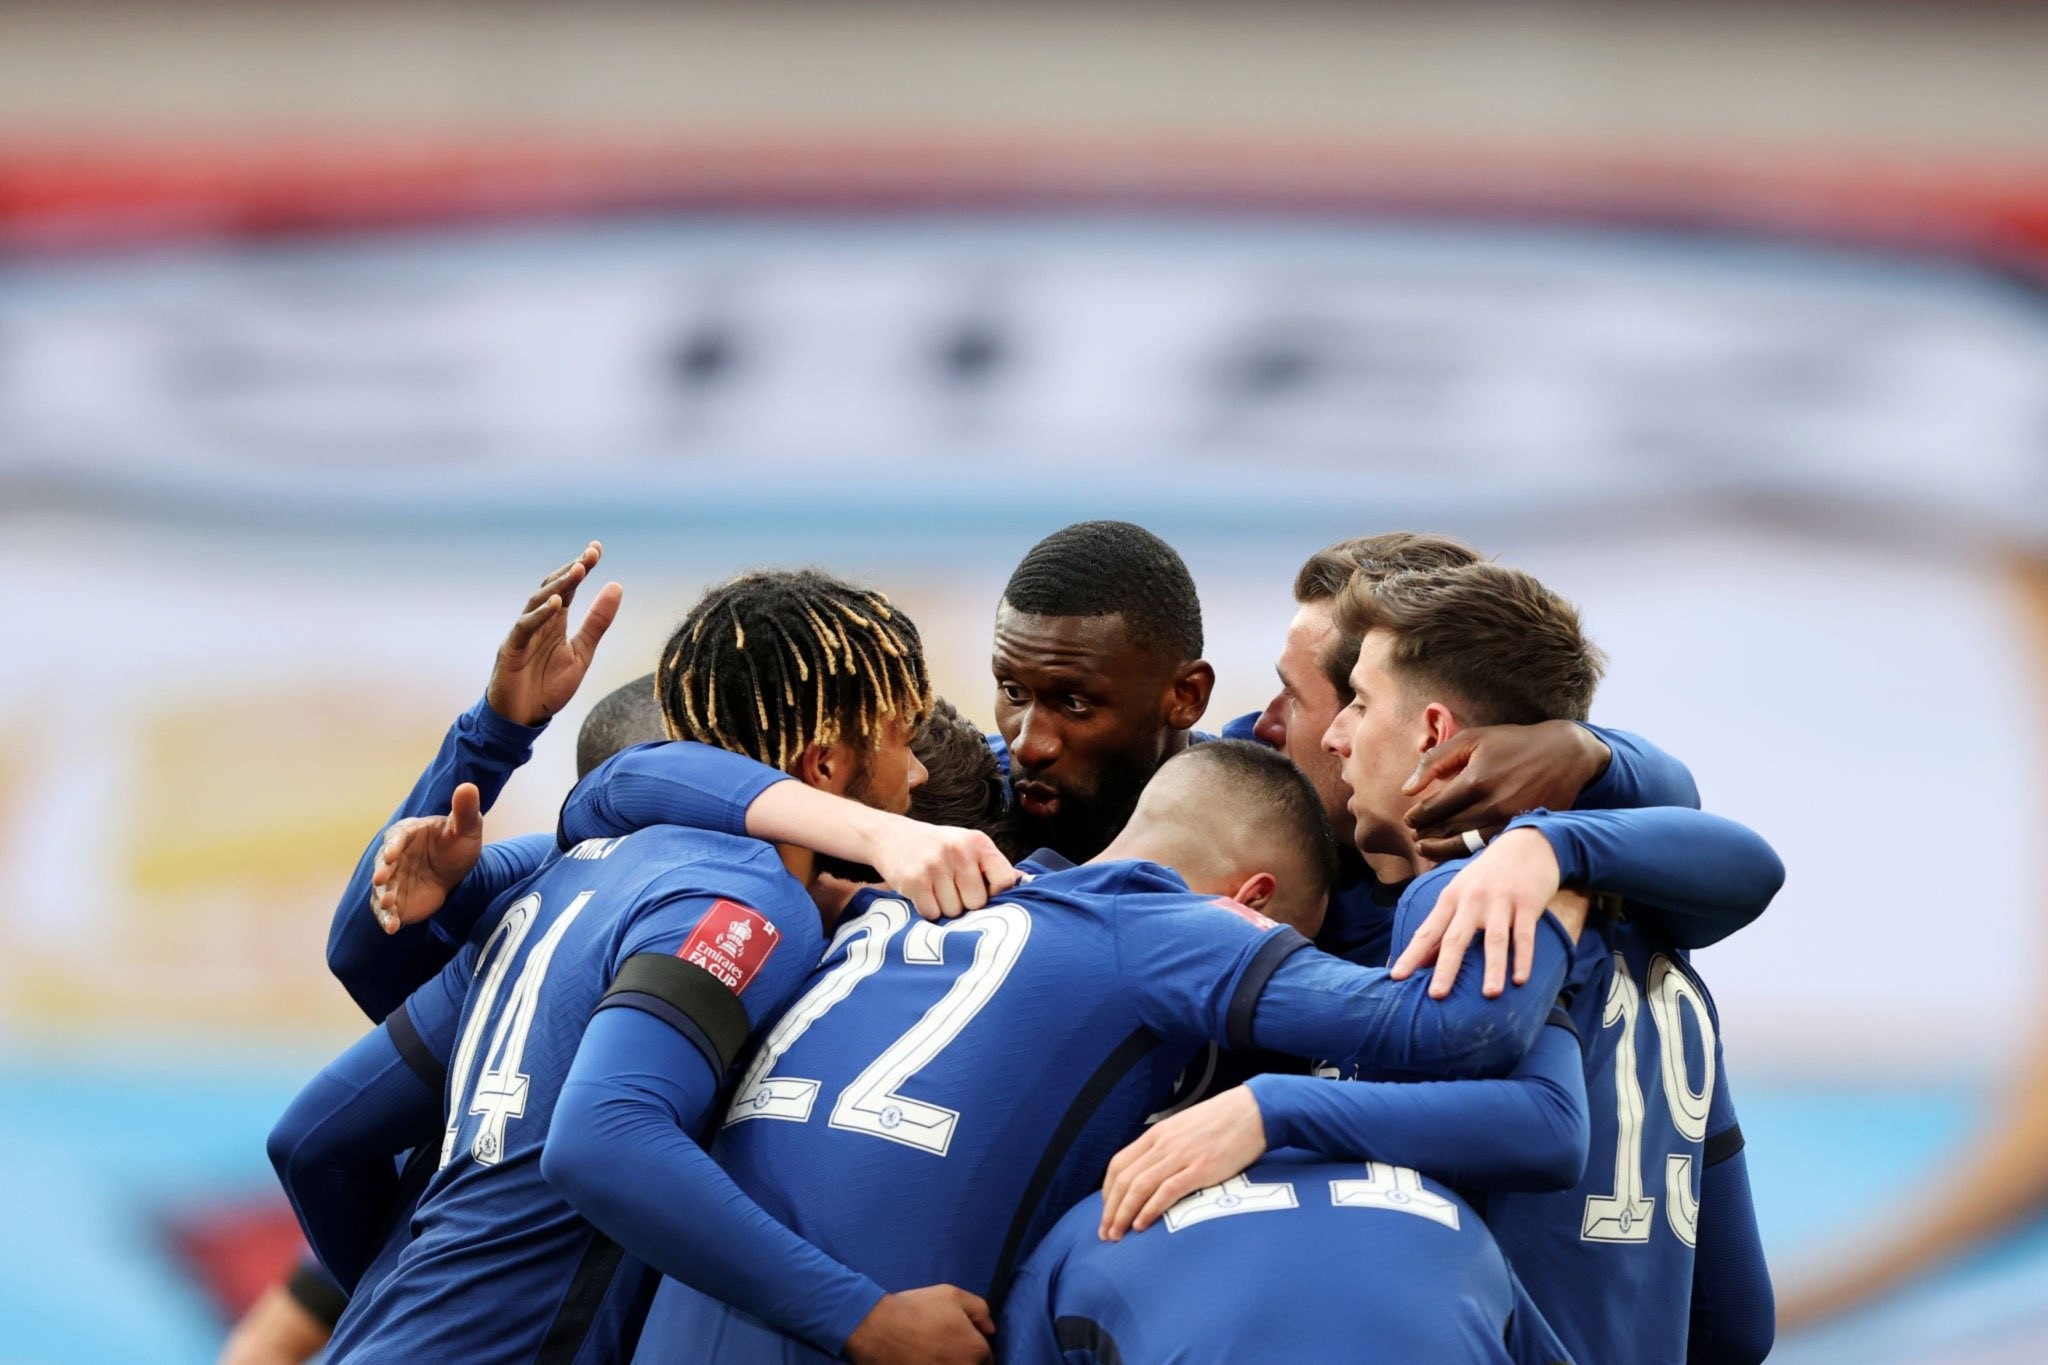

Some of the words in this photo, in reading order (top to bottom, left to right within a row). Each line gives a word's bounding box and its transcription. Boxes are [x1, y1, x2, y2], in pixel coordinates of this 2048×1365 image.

[439, 891, 596, 1171] 24
[688, 951, 708, 969] FA
[707, 963, 738, 987] CUP
[695, 941, 744, 979] Emirates
[721, 898, 1032, 1157] 22
[1580, 951, 1716, 1248] 19
